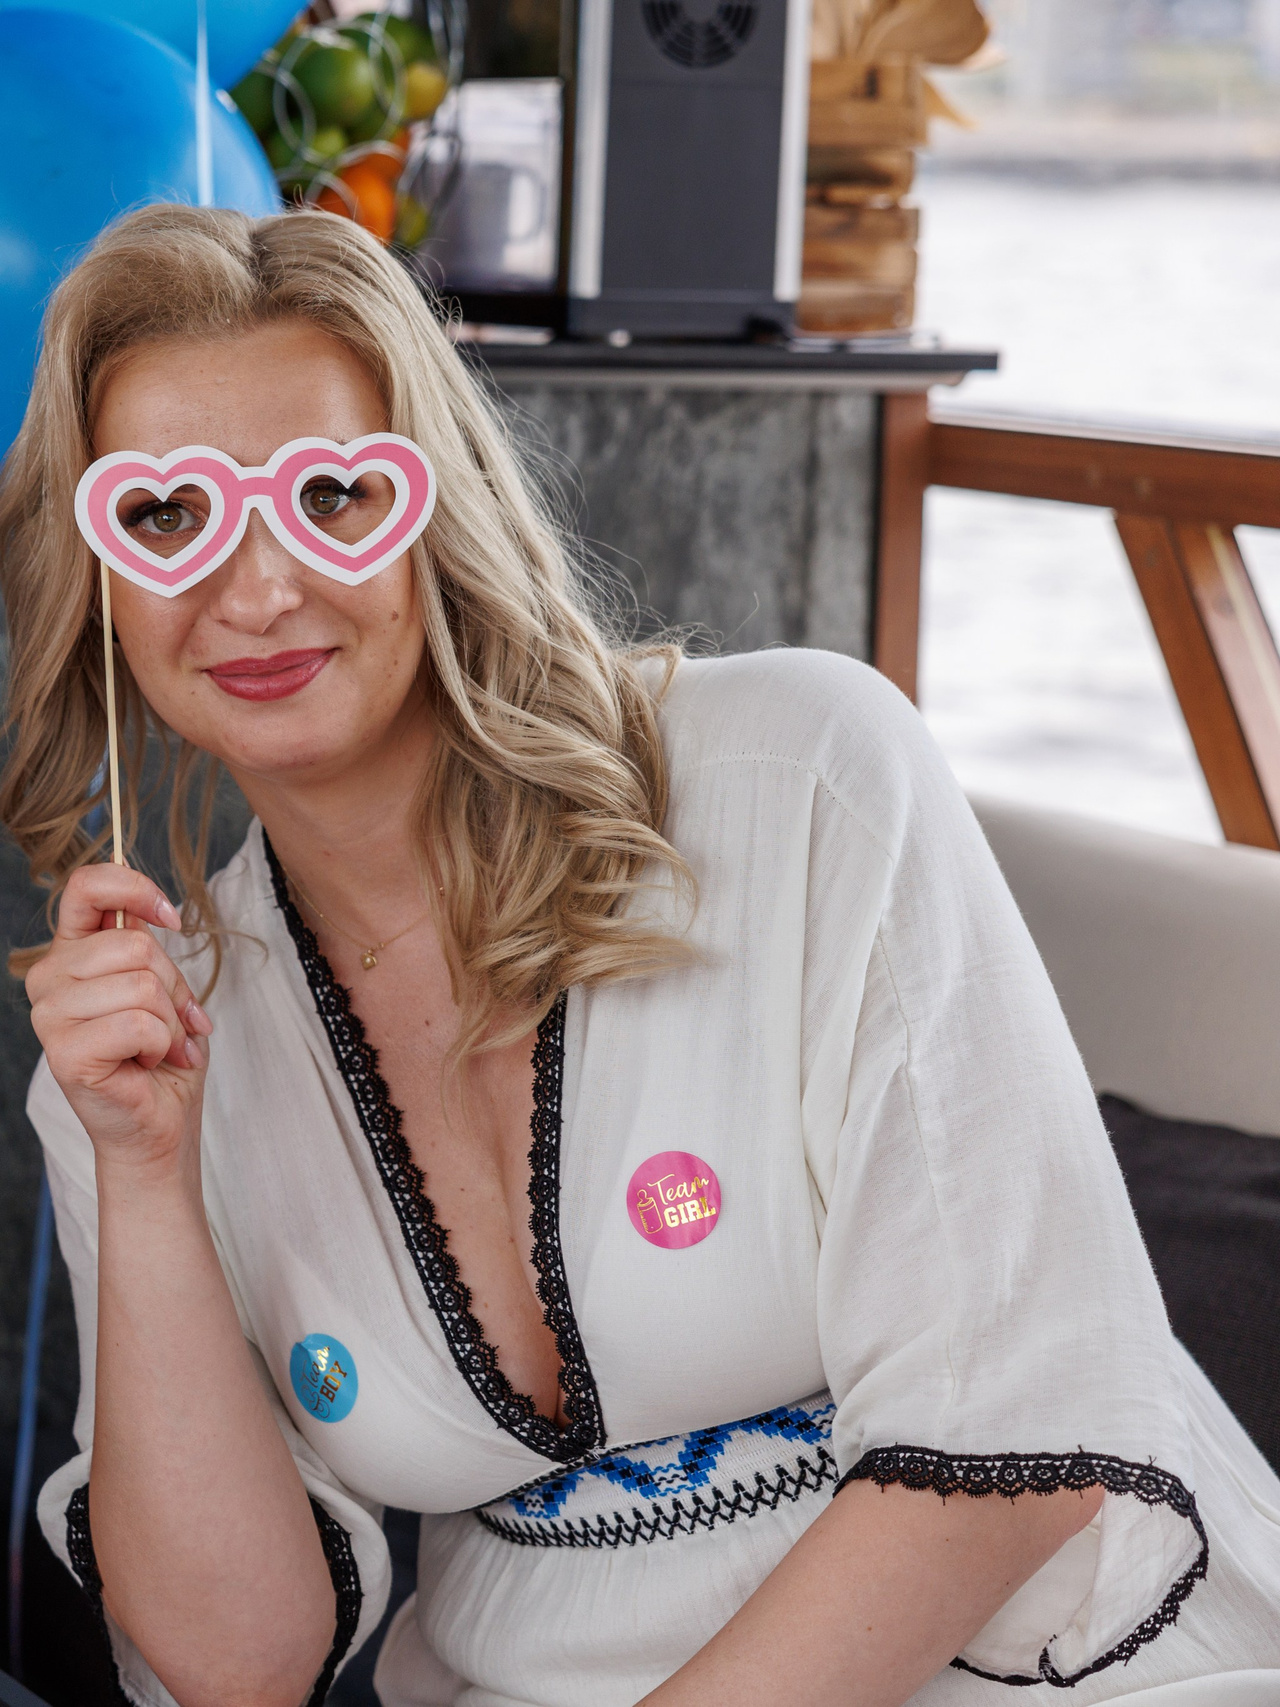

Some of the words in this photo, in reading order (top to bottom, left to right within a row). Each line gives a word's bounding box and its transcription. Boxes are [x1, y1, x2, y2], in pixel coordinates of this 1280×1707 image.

[647, 1173, 709, 1205] Team
[663, 1196, 716, 1228] GIRL
[319, 1360, 347, 1403] BOY
